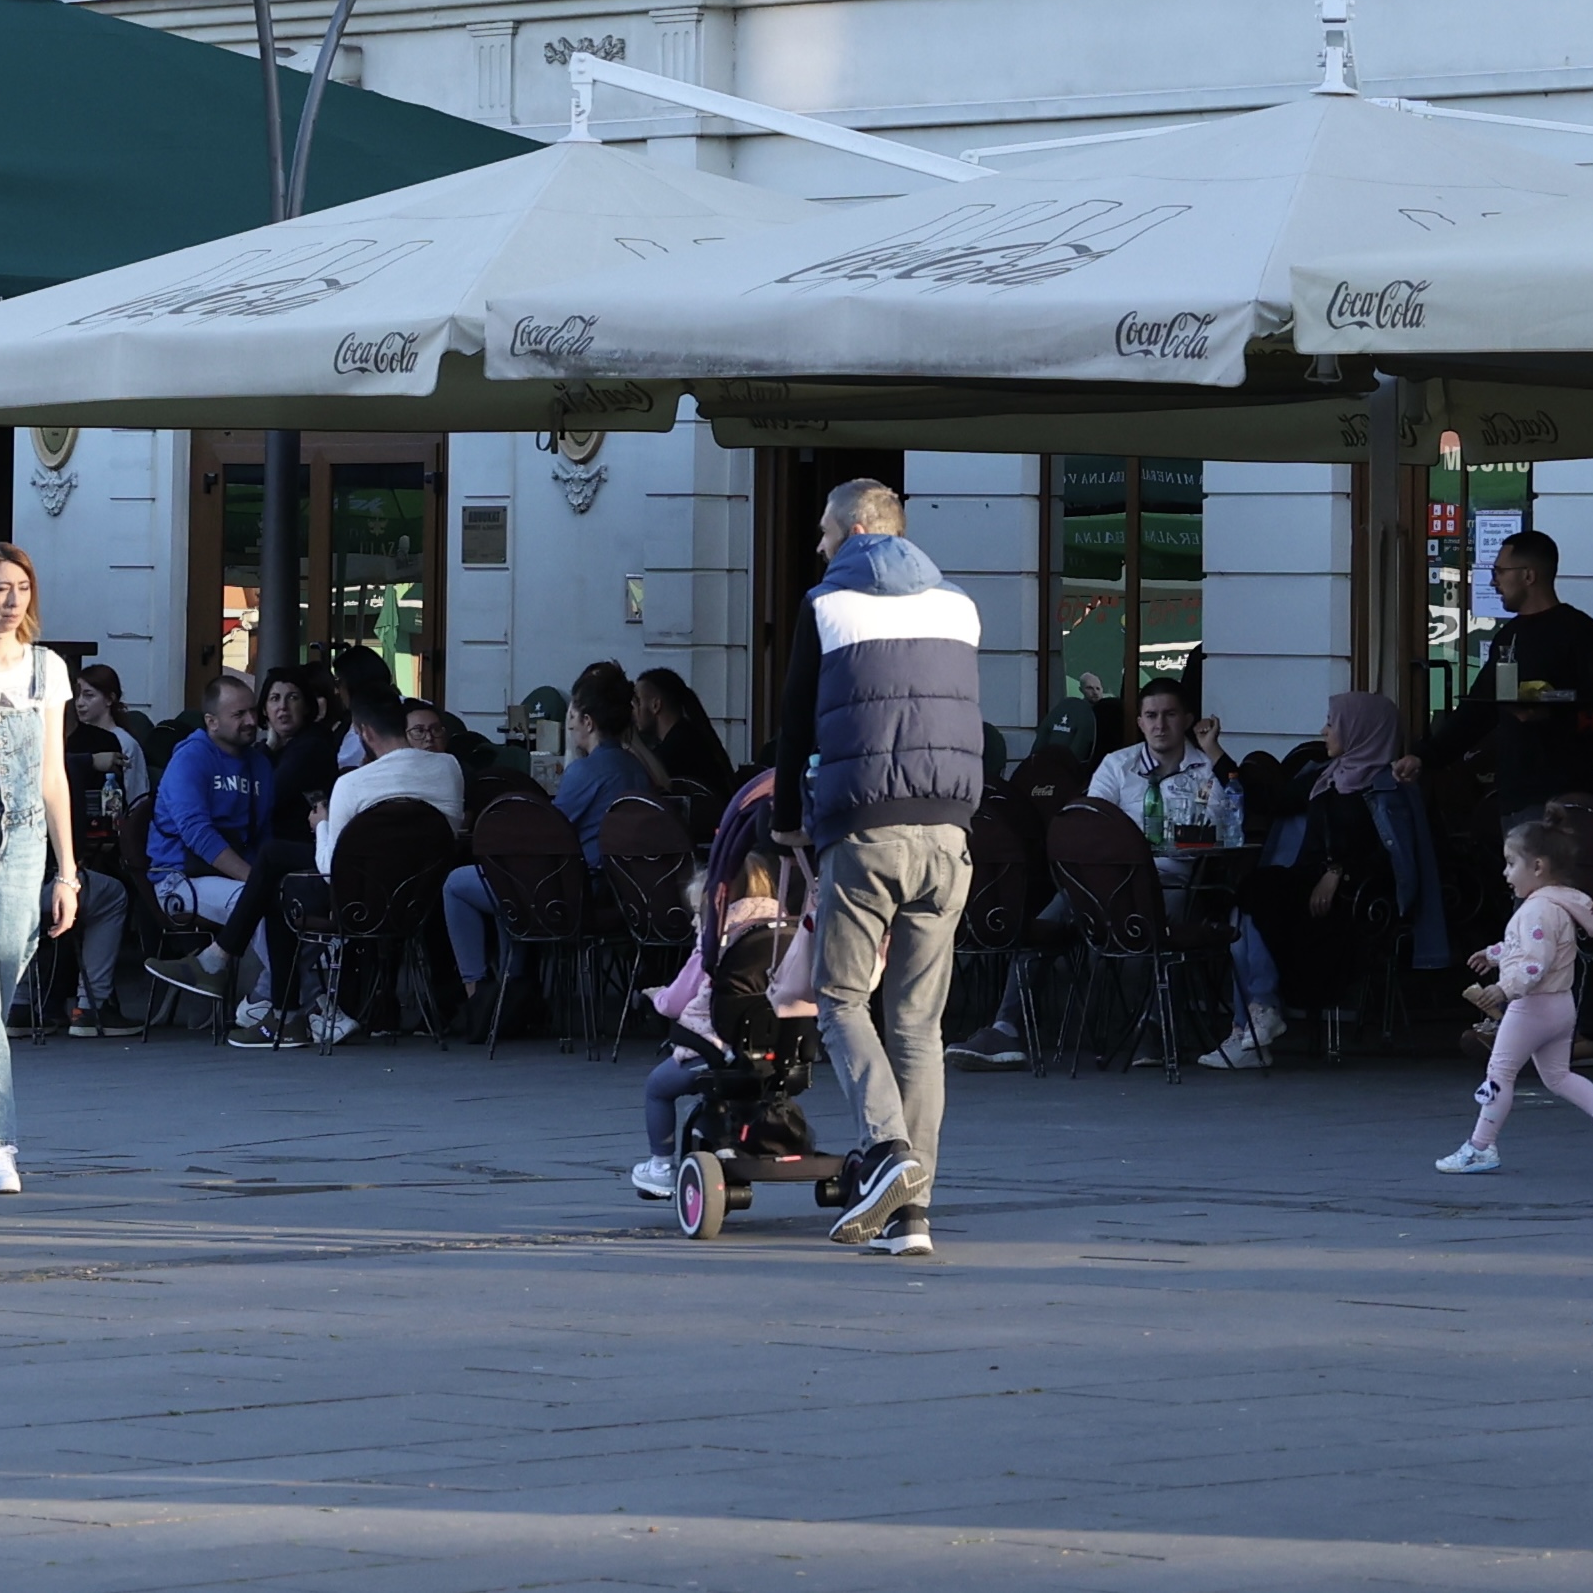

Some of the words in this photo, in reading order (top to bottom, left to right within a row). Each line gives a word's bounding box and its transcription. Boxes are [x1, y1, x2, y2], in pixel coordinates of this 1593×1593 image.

[1325, 278, 1433, 332] Coca-Cola
[334, 331, 419, 375] Coca-Cola
[510, 314, 600, 358] Coca-Cola
[1115, 310, 1218, 360] Coca-Cola
